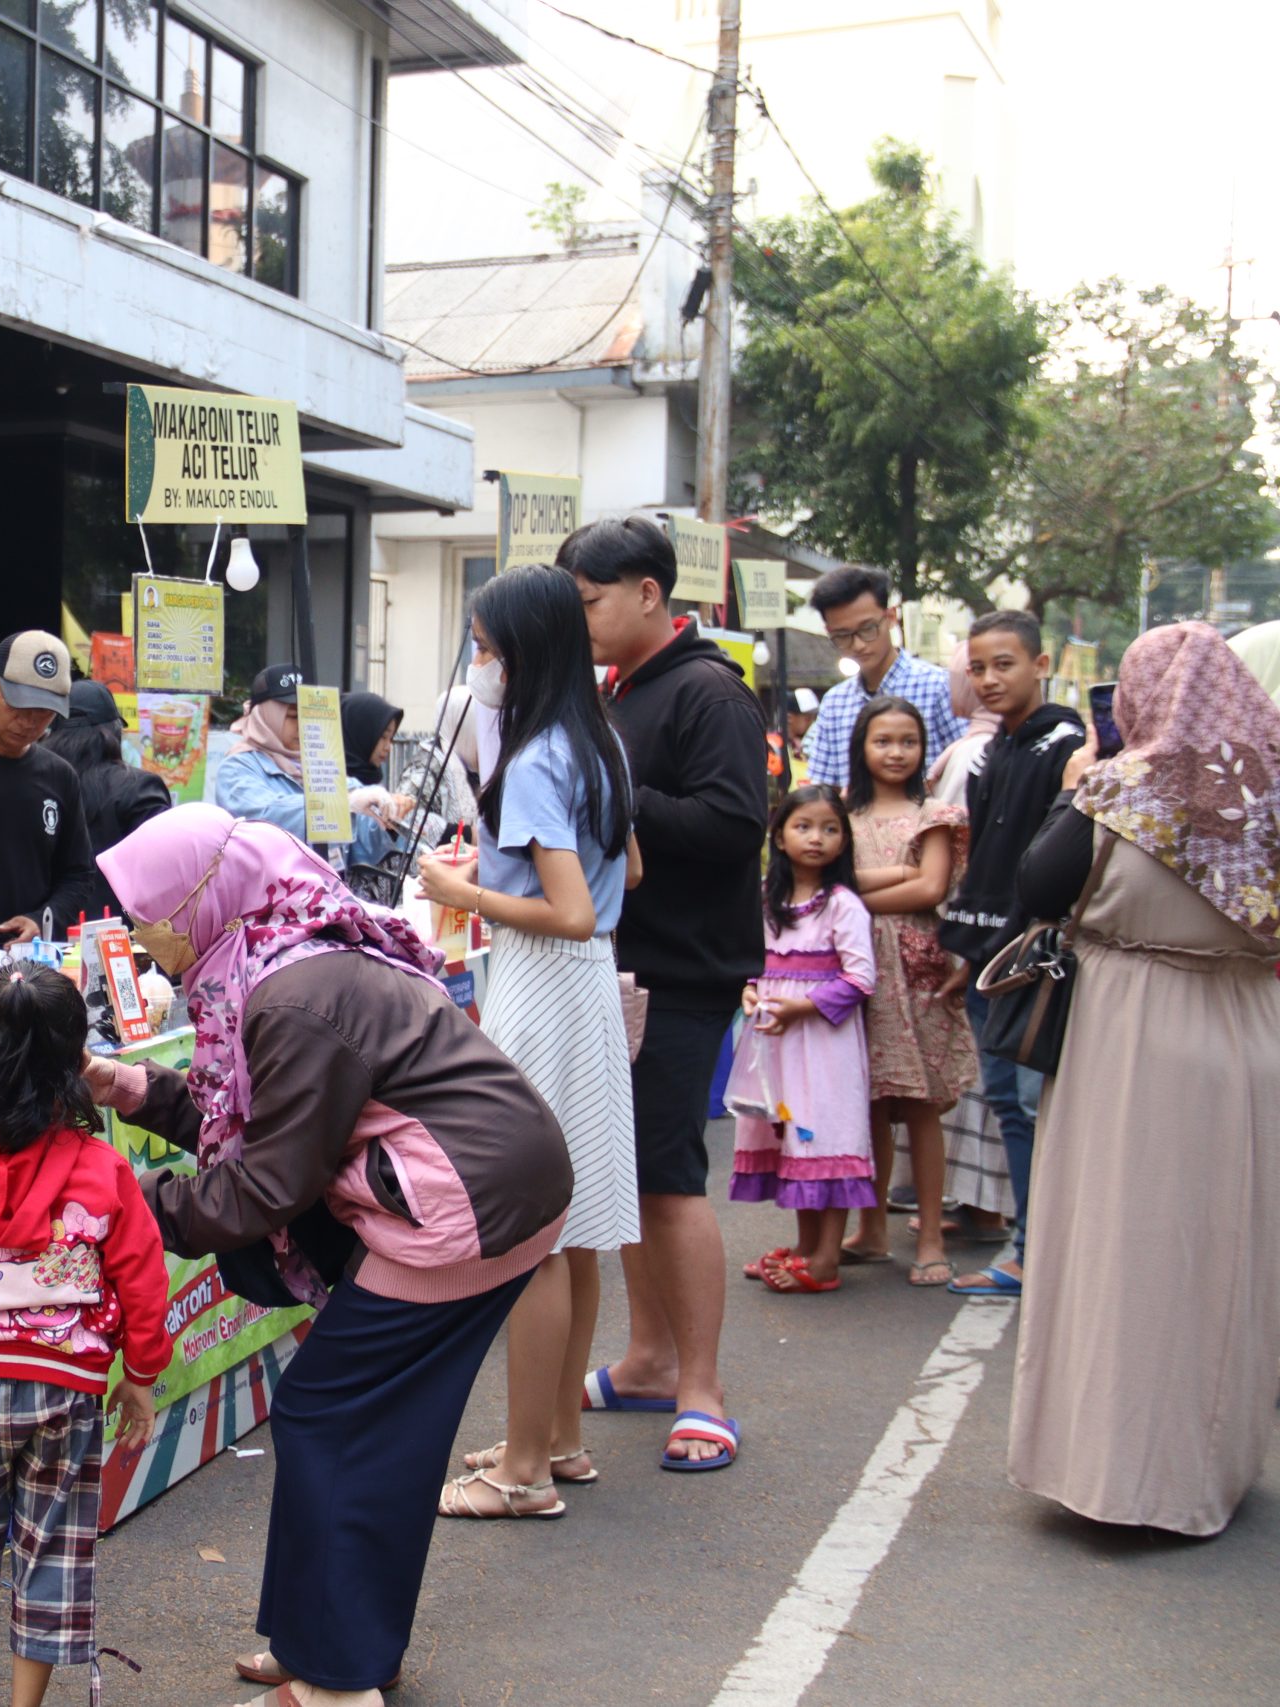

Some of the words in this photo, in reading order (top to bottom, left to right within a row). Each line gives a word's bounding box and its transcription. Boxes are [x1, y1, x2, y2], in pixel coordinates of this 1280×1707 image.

[153, 402, 234, 444] MAKARONI
[236, 410, 281, 446] TELUR
[181, 444, 208, 480] ACI
[211, 445, 260, 481] TELUR
[164, 488, 182, 508] BY:
[186, 489, 236, 509] MAKLOR
[240, 490, 278, 509] ENDUL
[530, 493, 577, 535] CHICKEN
[183, 1322, 218, 1366] Makroni
